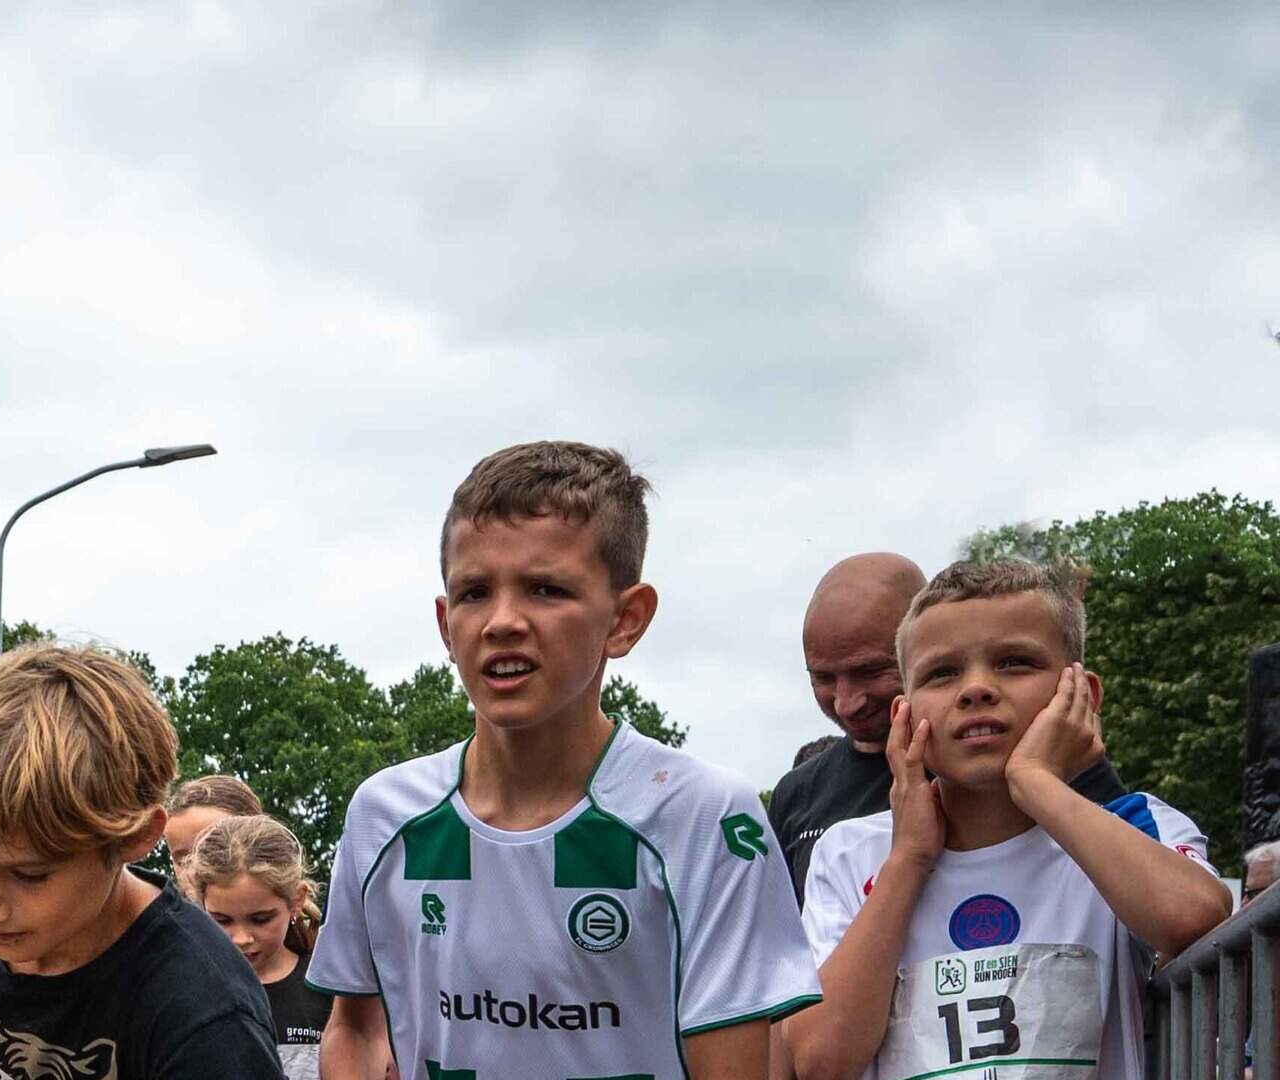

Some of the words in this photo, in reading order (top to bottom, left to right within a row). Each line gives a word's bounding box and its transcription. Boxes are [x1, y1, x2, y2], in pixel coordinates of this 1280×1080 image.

[974, 960, 984, 972] OT
[986, 959, 997, 970] en
[998, 955, 1018, 969] SIEN
[974, 970, 990, 983] RUN
[992, 967, 1017, 981] RODEN
[440, 989, 620, 1030] autokan
[937, 995, 1021, 1064] 13
